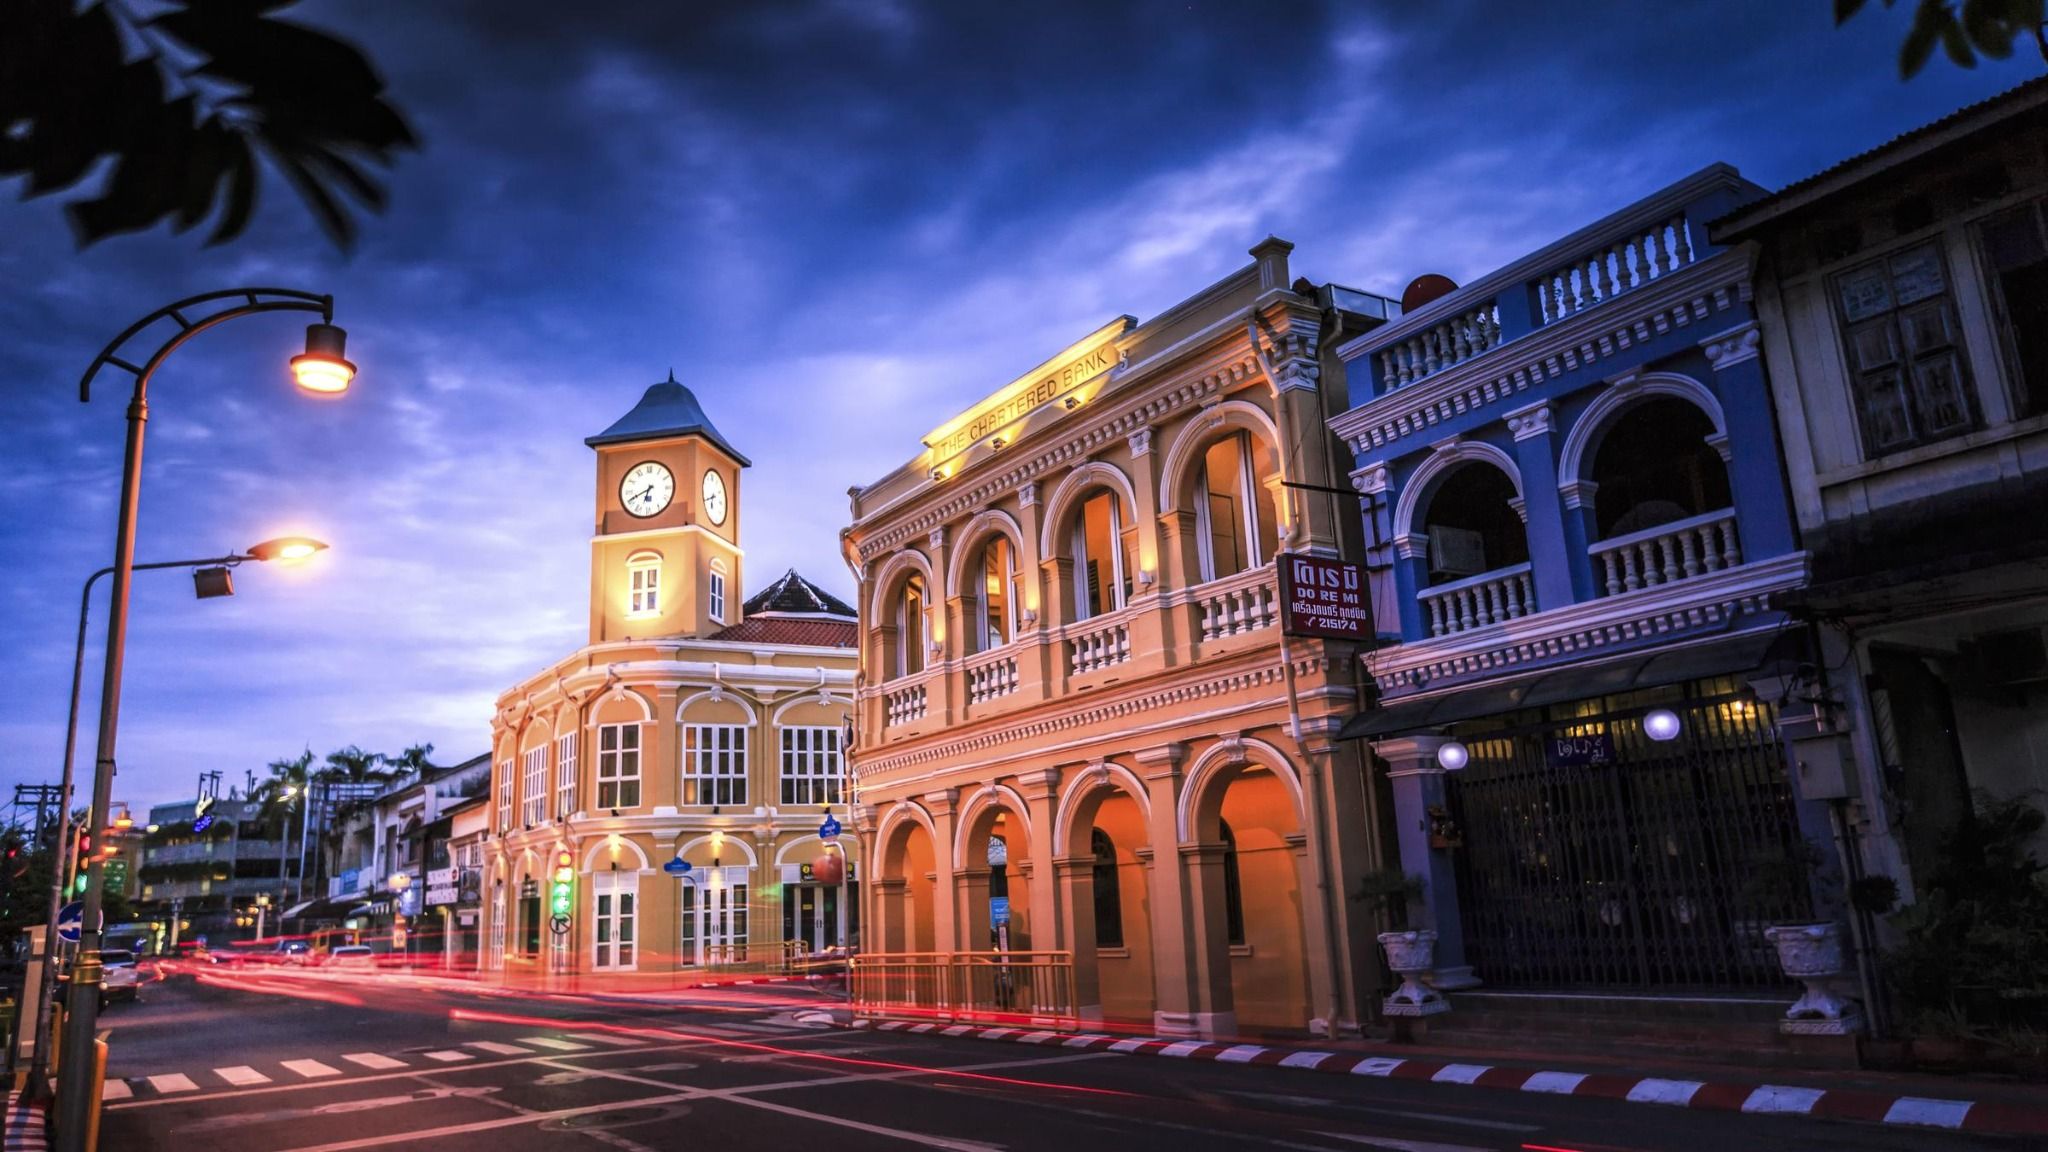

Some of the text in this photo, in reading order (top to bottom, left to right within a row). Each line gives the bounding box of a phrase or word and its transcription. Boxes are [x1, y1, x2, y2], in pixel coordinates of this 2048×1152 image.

[941, 349, 1107, 456] THE CHARTERED BANK
[1297, 588, 1358, 604] DO RE MI
[1319, 617, 1357, 630] 215174
